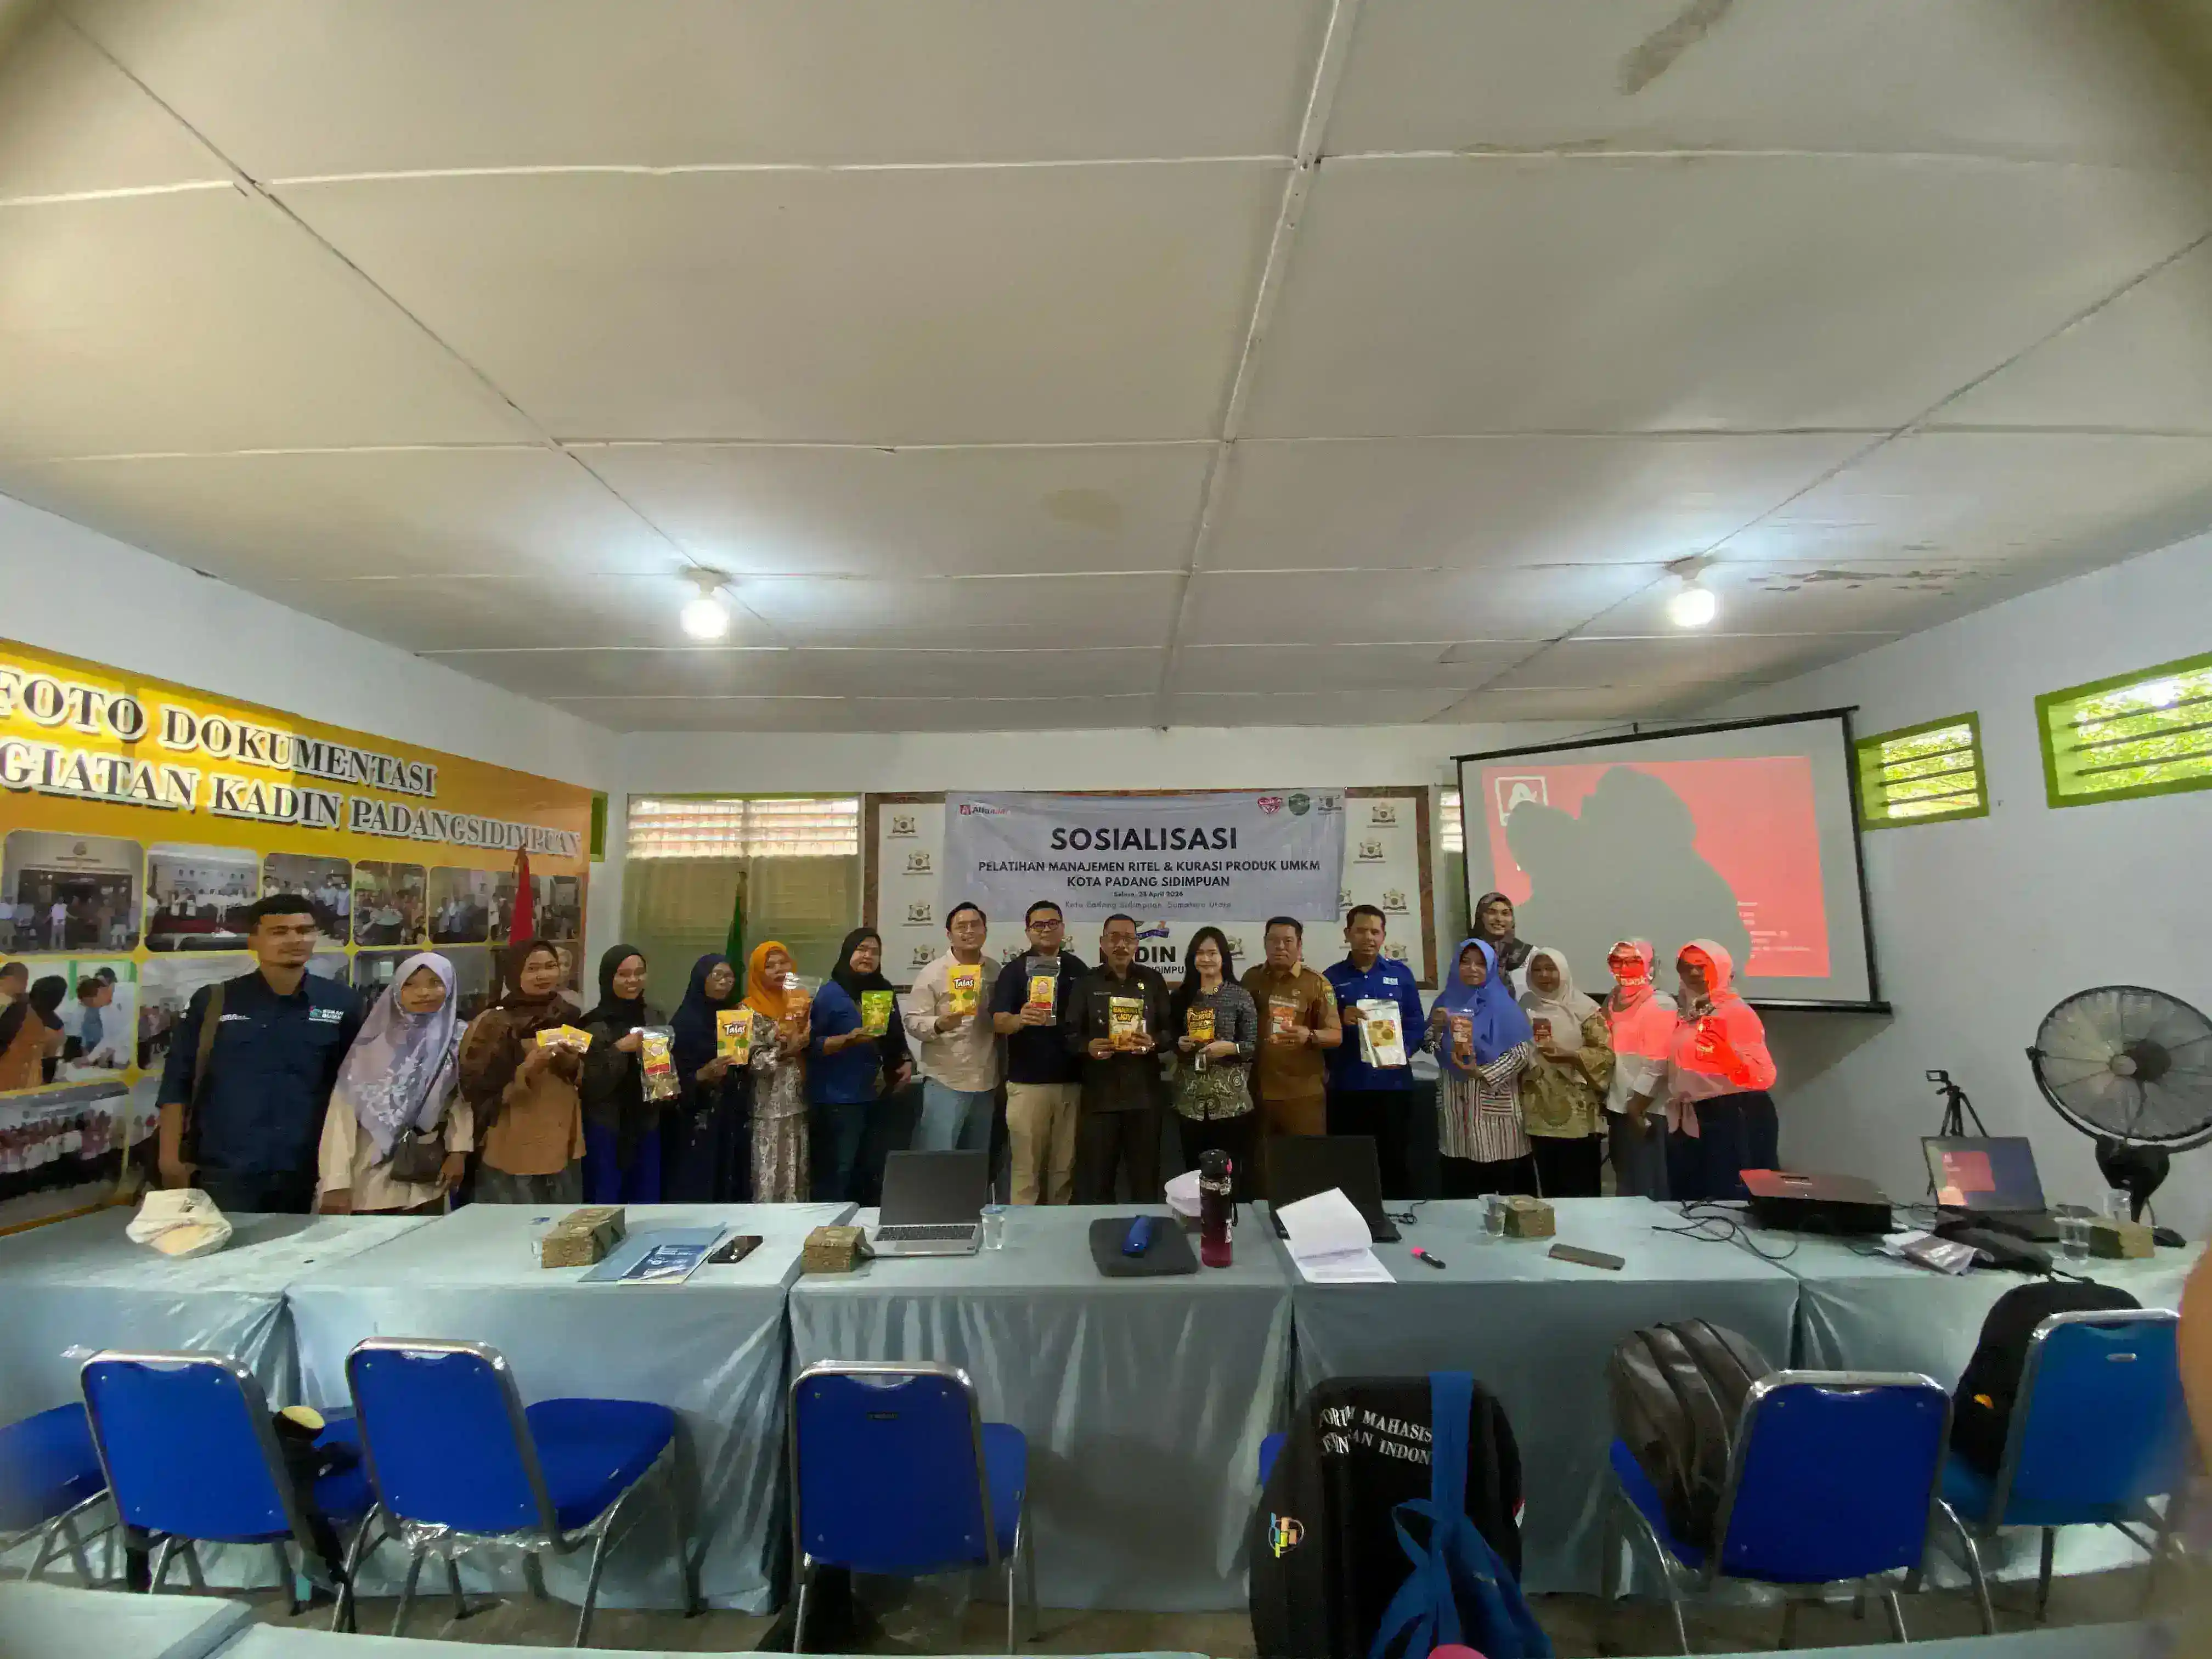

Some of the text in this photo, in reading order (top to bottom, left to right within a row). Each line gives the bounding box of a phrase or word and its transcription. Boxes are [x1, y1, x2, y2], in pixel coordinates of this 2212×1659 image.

[165, 708, 436, 794] DOKUMENTASI
[212, 776, 340, 828] KADIN
[351, 798, 581, 856] PADANGSIDIMPUAN
[1050, 827, 1237, 851] SOSIALISASI
[978, 860, 1320, 872] PELATIHAN MANAJEMEN RITEL & KURASI PRODUK UMKM
[1067, 876, 1230, 887] KOTA PADANG SIDIMPUAN
